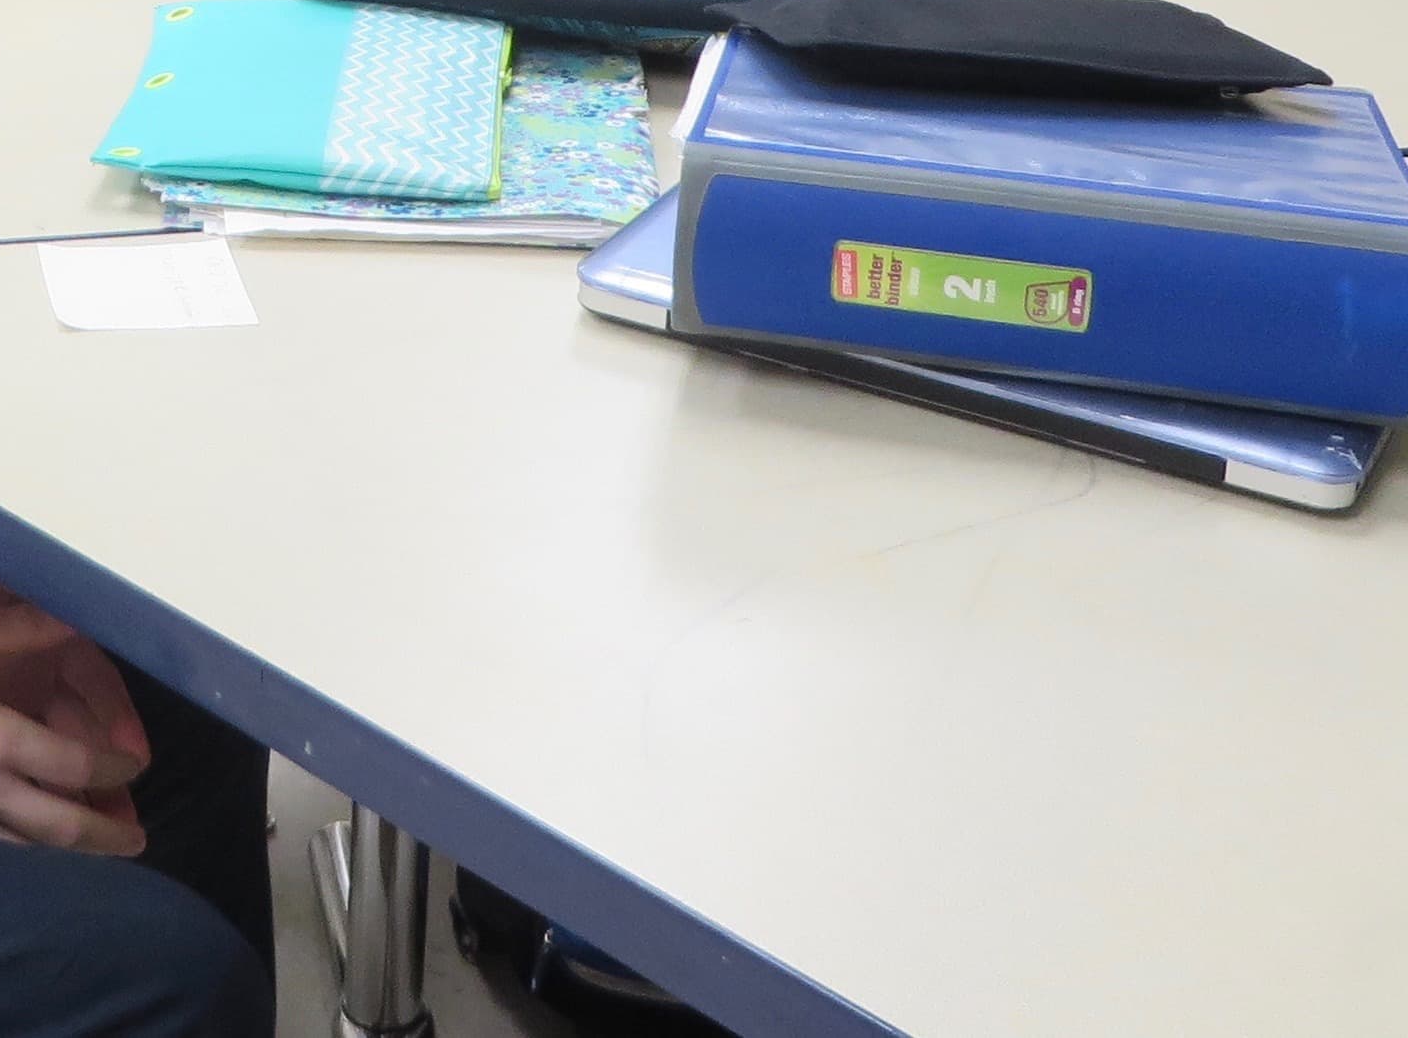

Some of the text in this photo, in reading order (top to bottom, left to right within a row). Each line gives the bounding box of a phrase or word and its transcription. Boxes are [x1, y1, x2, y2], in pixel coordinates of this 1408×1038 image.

[841, 252, 854, 296] STAPLES
[867, 253, 884, 300] better
[884, 256, 904, 306] binder
[943, 274, 982, 303] 2
